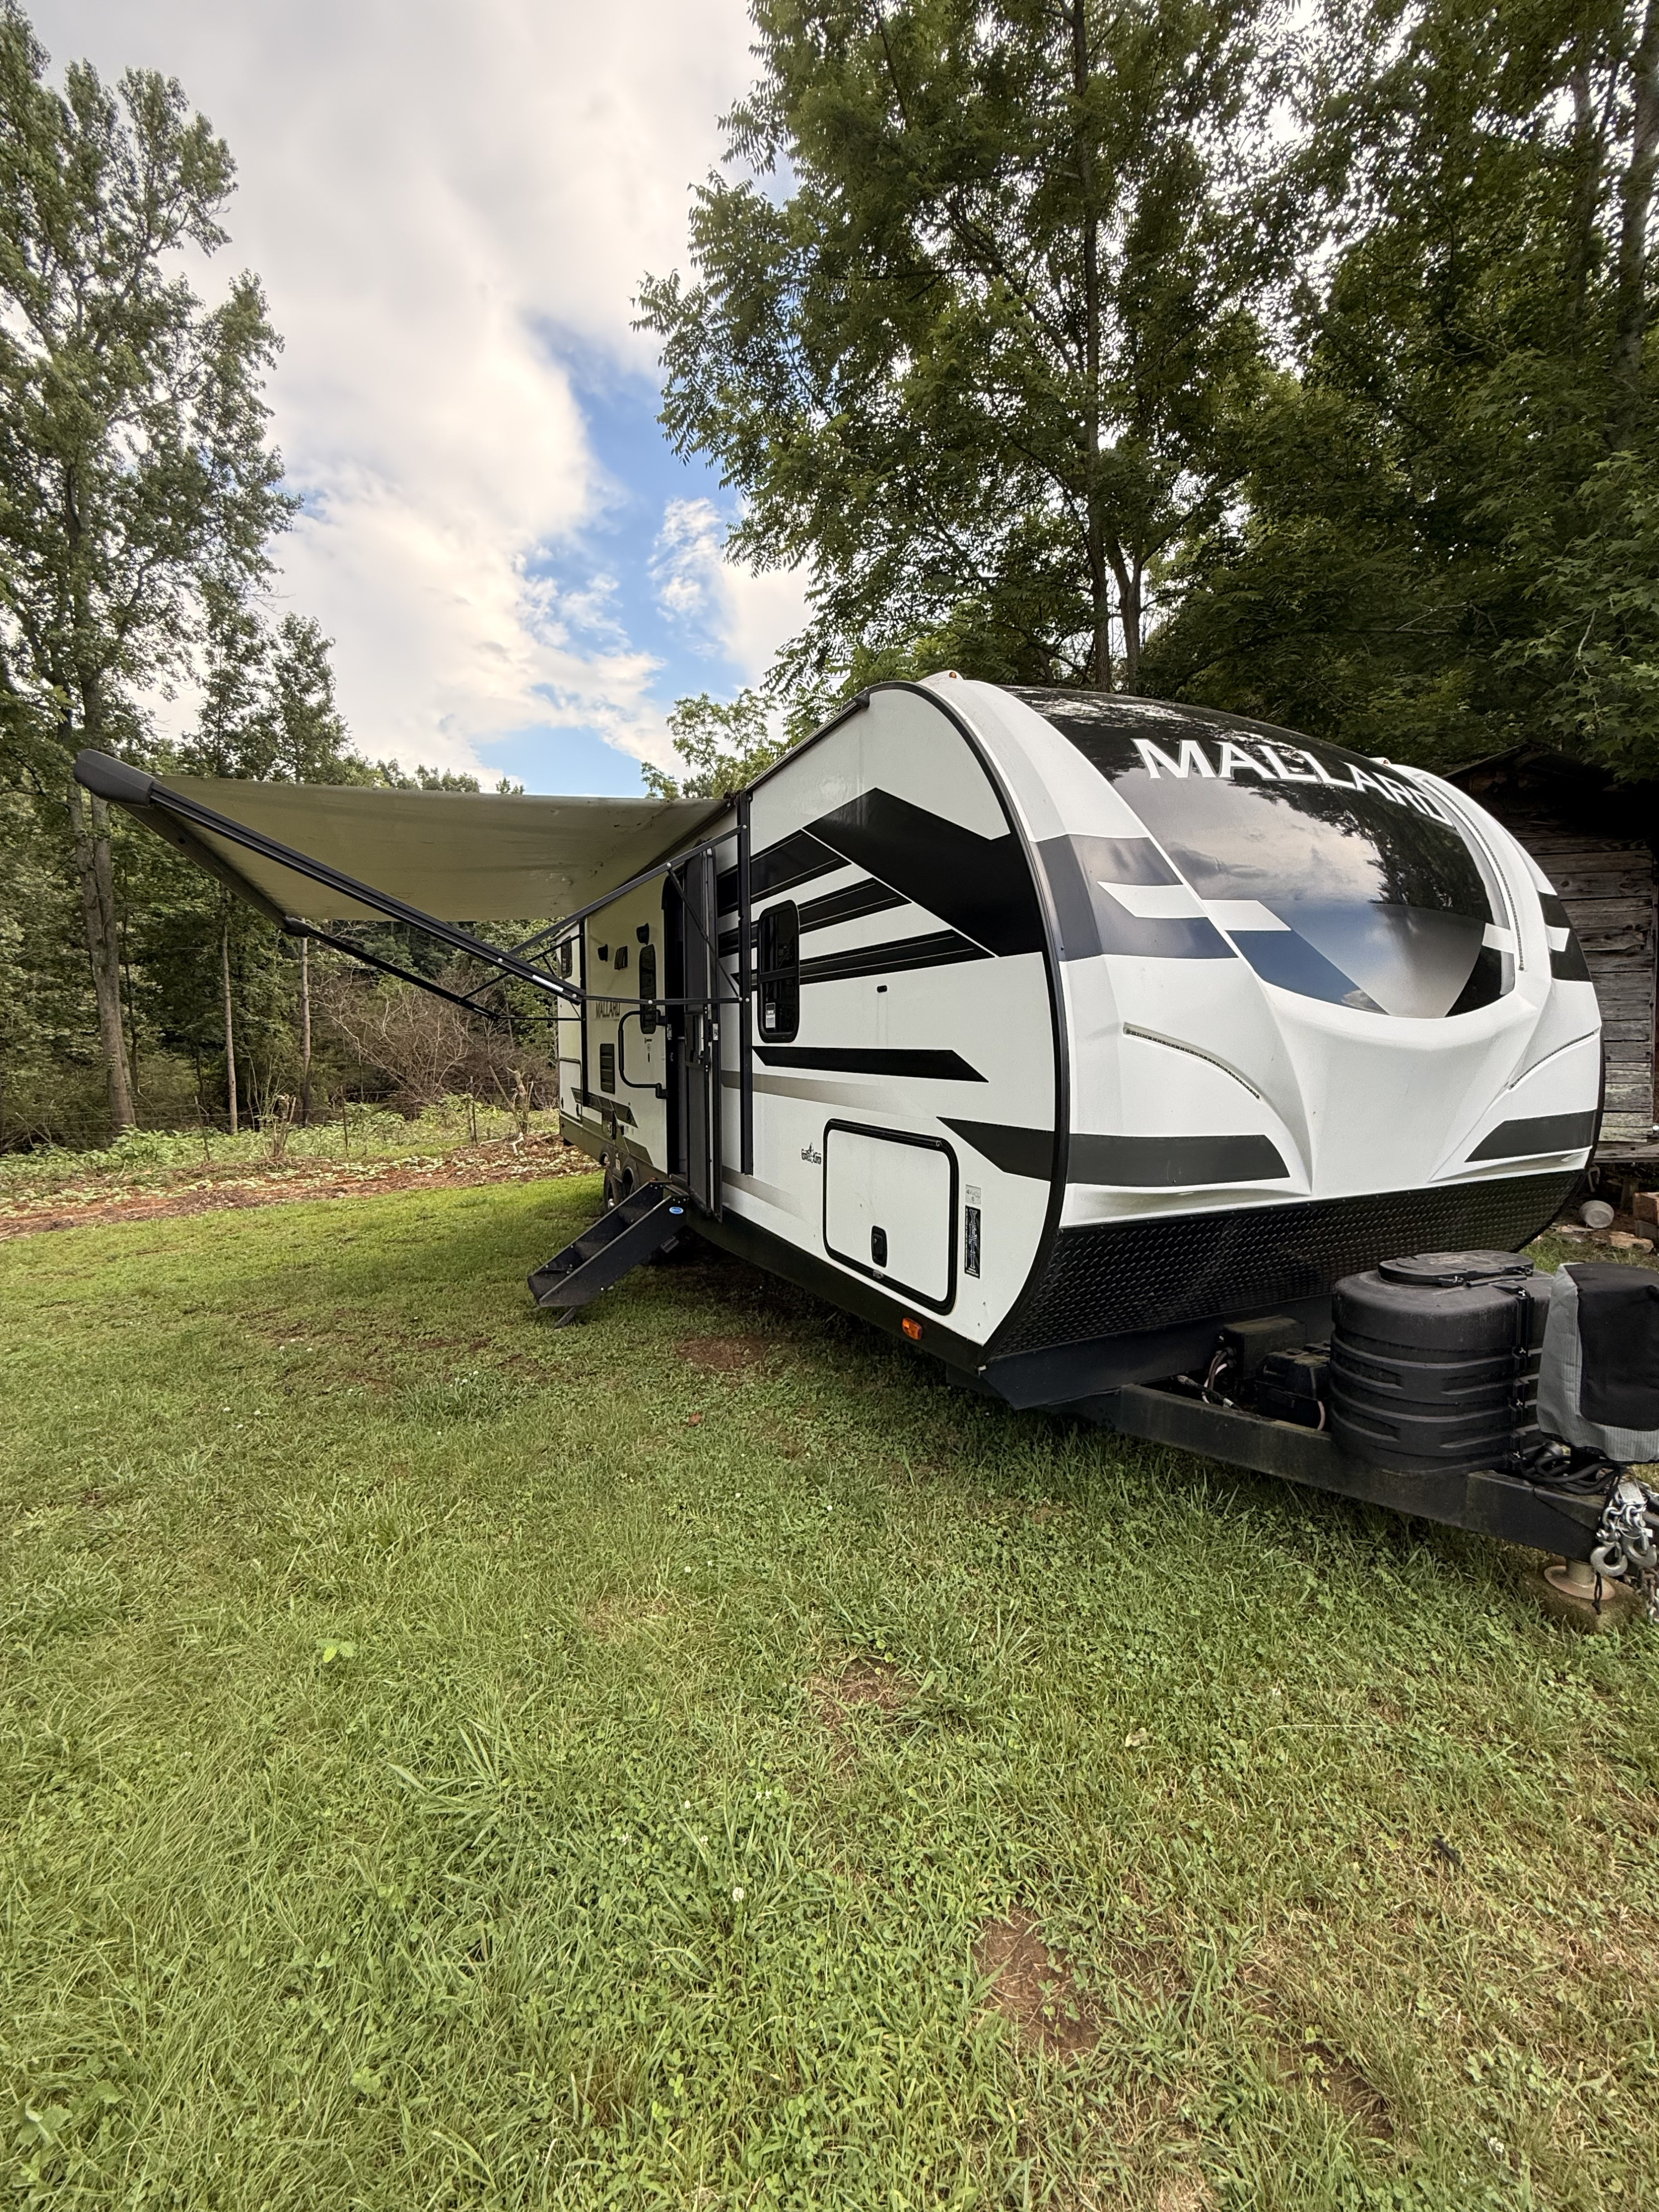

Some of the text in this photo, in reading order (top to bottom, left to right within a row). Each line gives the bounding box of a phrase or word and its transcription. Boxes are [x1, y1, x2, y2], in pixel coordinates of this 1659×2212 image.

[1130, 738, 1453, 826] MALLARD
[596, 1000, 620, 1019] MALLARD
[968, 1209, 978, 1269] YETI
